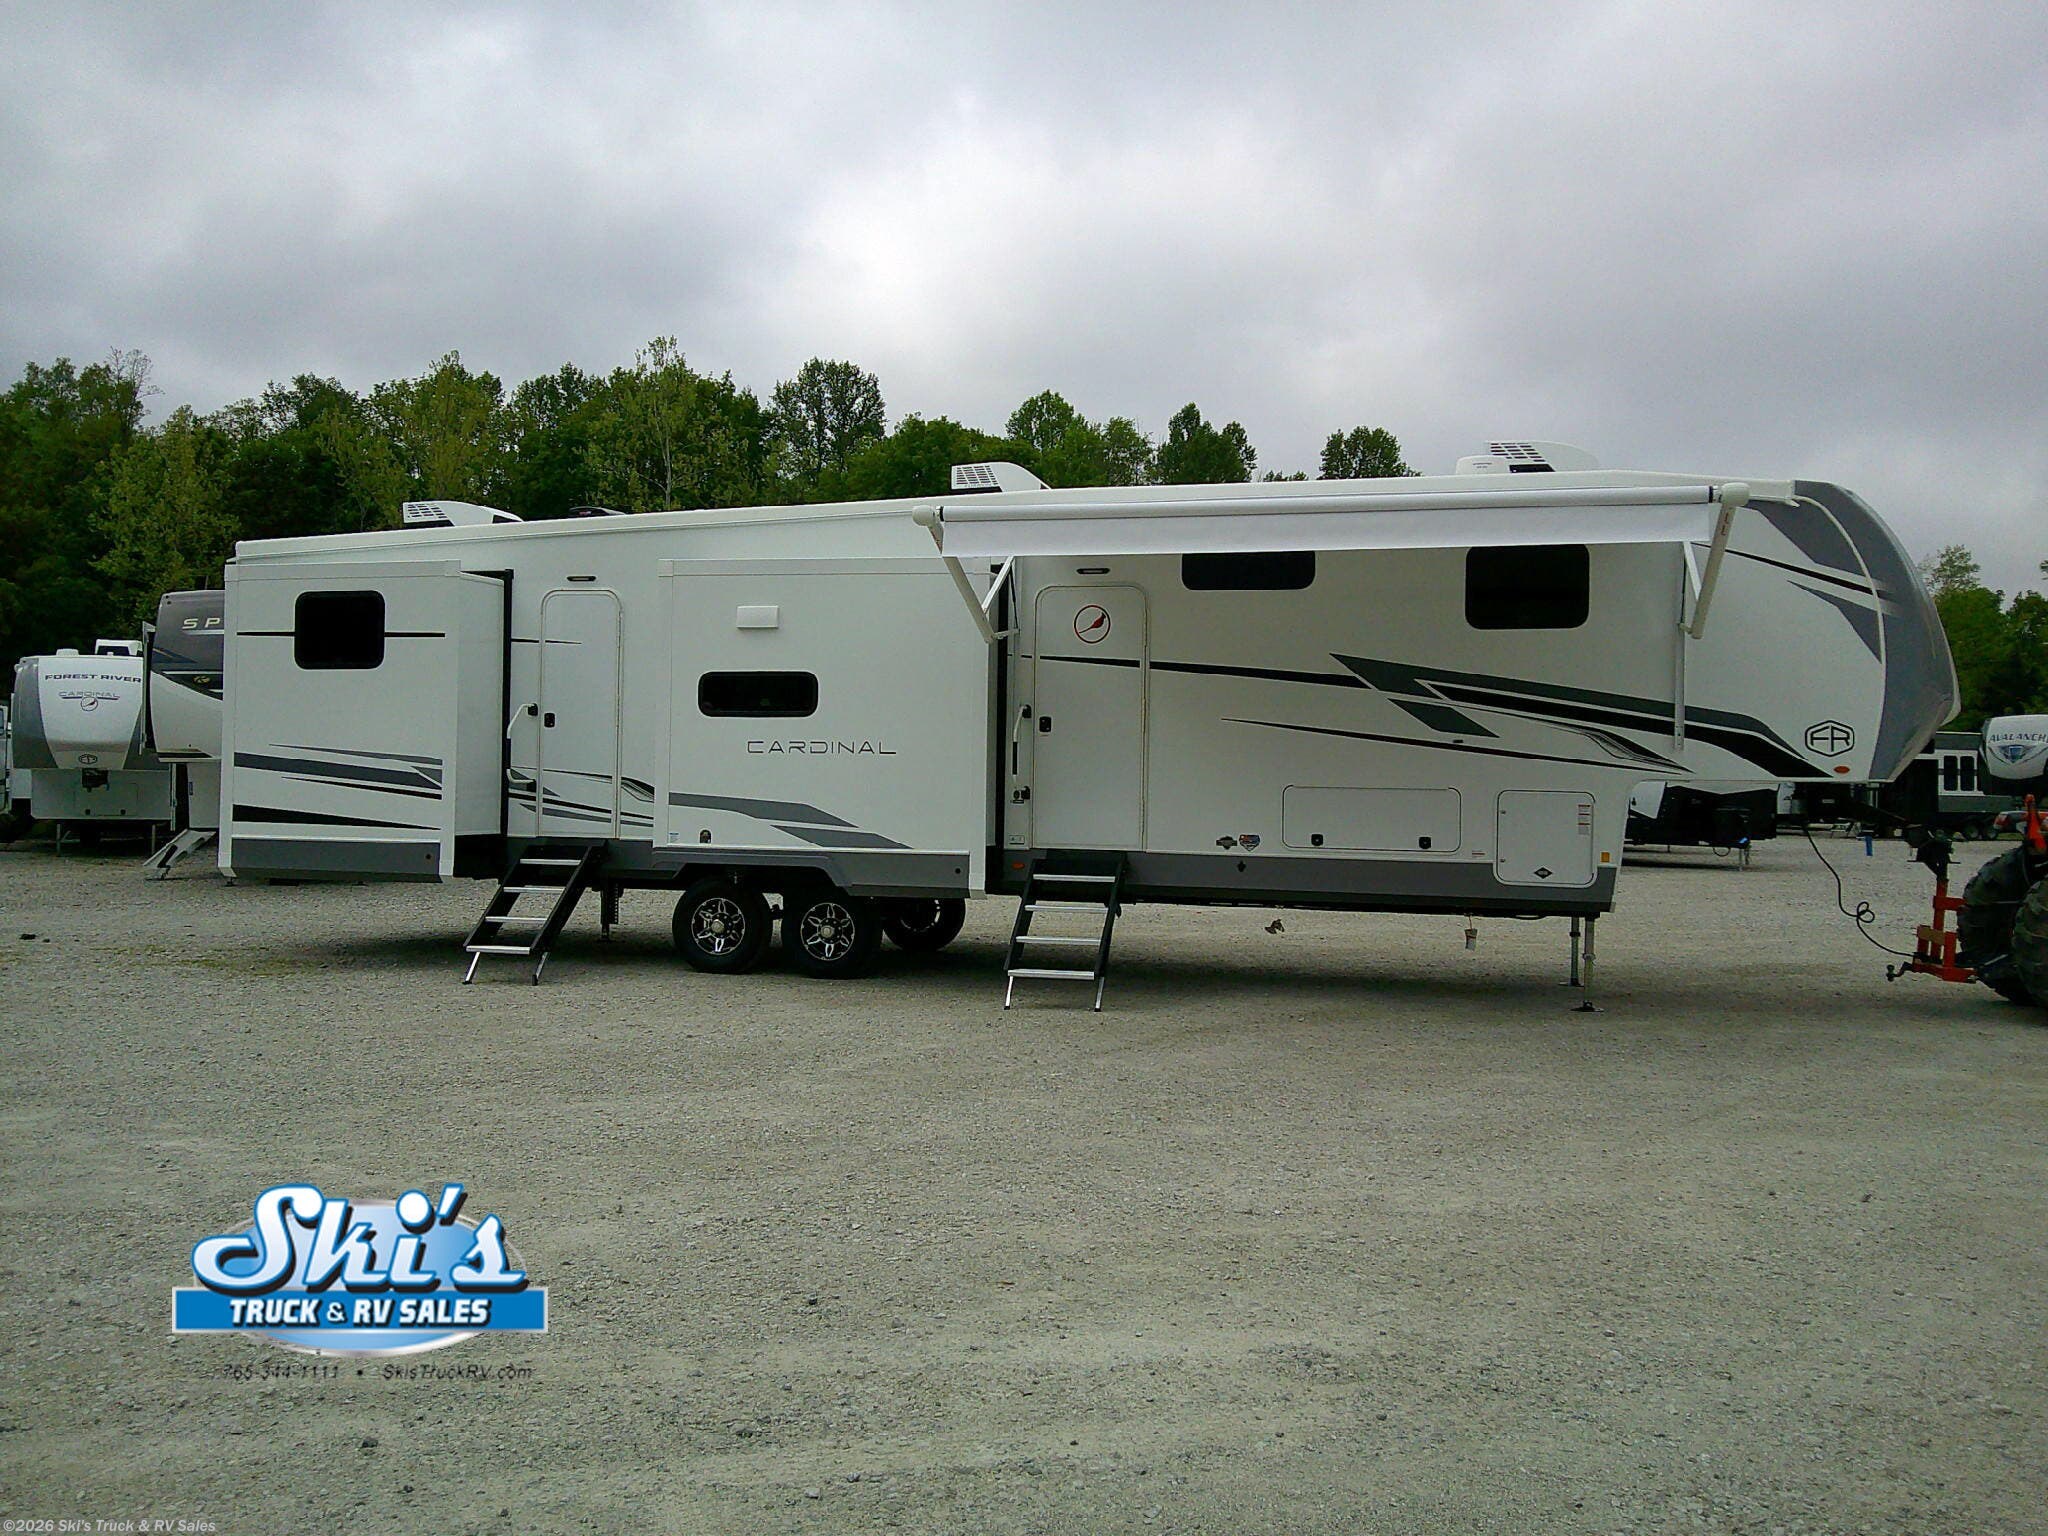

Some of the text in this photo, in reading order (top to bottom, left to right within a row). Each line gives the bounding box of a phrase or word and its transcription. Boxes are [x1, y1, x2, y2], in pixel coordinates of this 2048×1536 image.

[45, 673, 142, 683] FOREST RIVER
[1991, 733, 2048, 744] AVALANCH
[747, 740, 897, 755] CARDINAL
